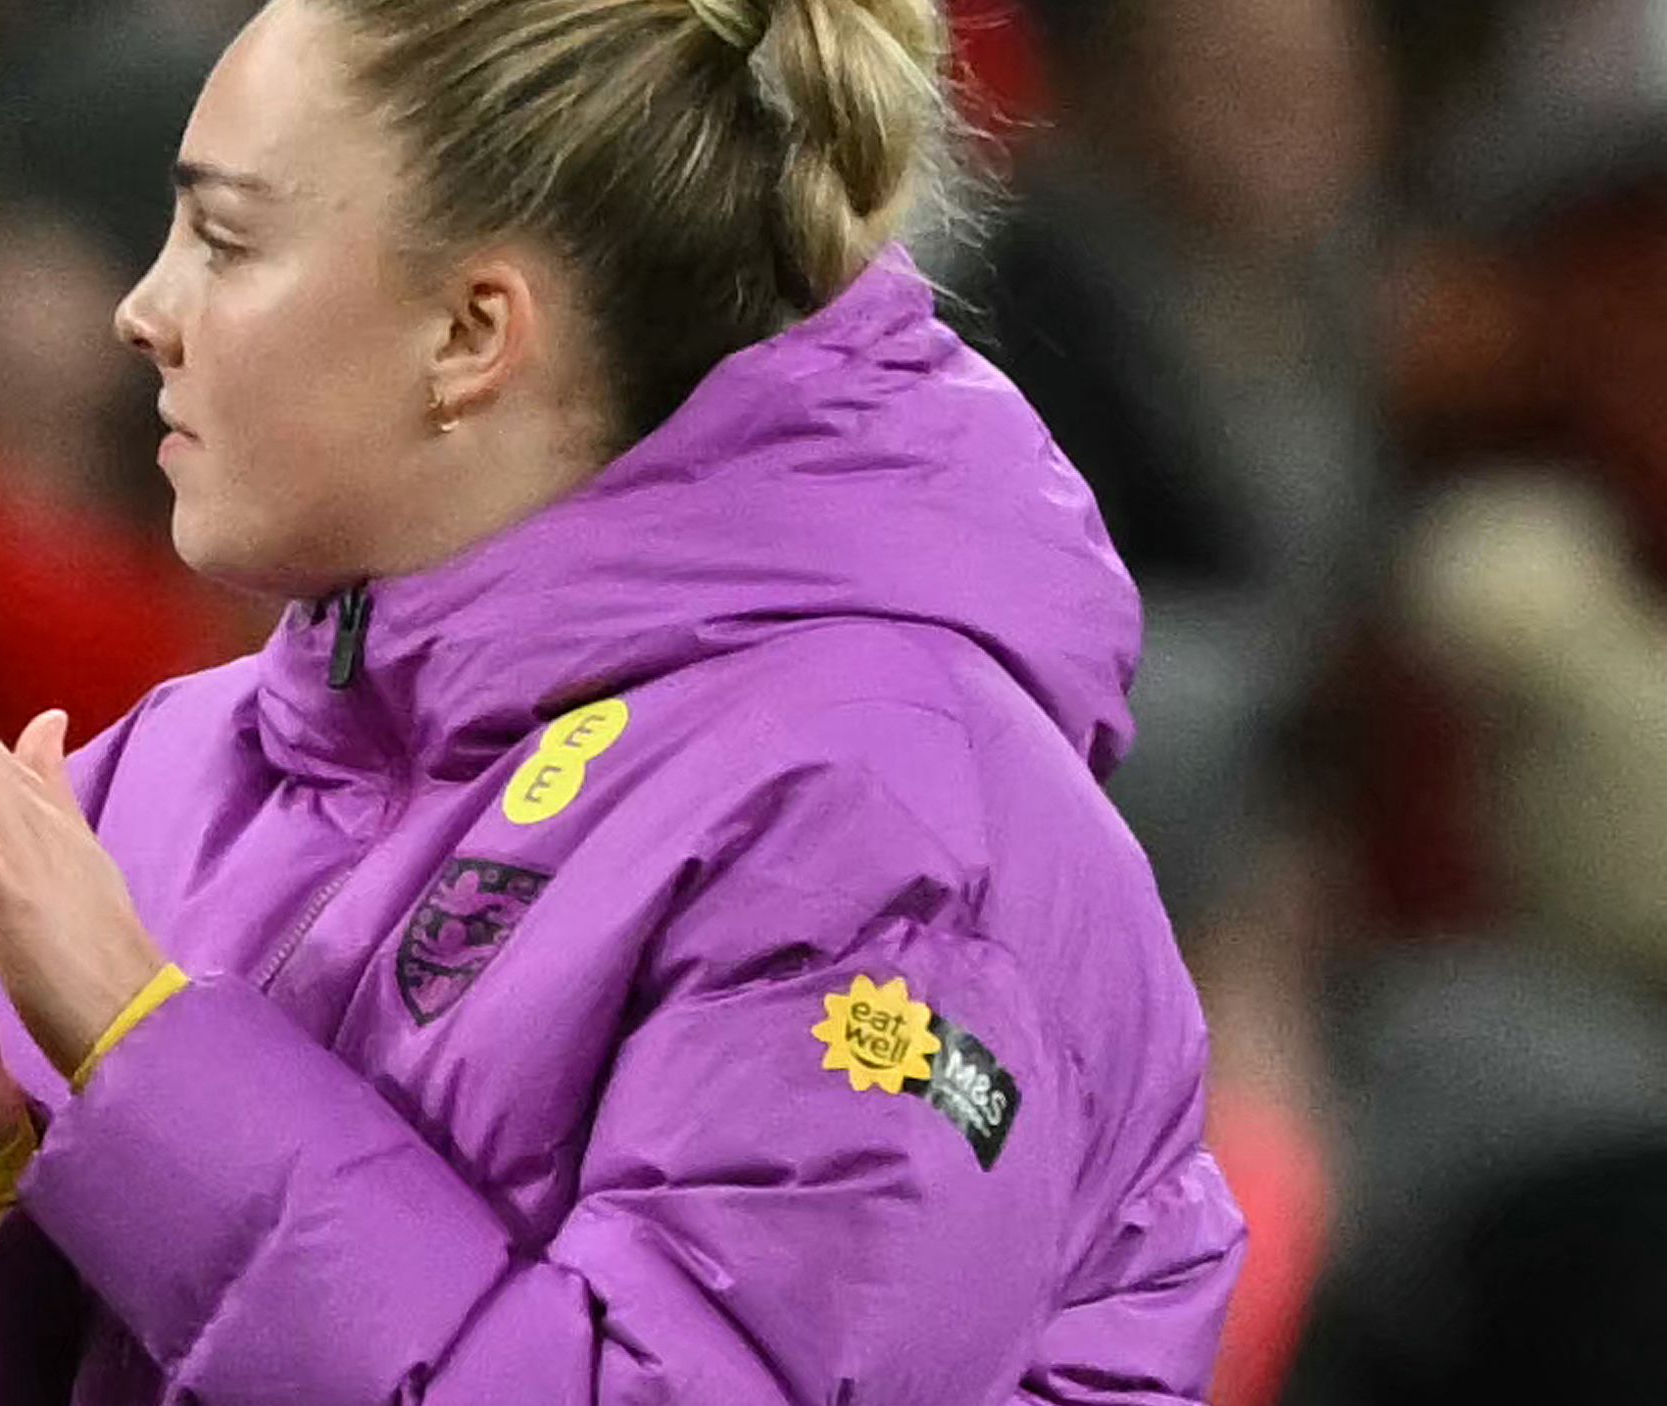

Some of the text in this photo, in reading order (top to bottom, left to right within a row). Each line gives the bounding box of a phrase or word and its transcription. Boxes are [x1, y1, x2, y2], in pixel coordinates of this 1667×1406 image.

[851, 1002, 906, 1036] eat
[845, 1022, 910, 1063] well
[945, 1050, 1007, 1126] M&S
